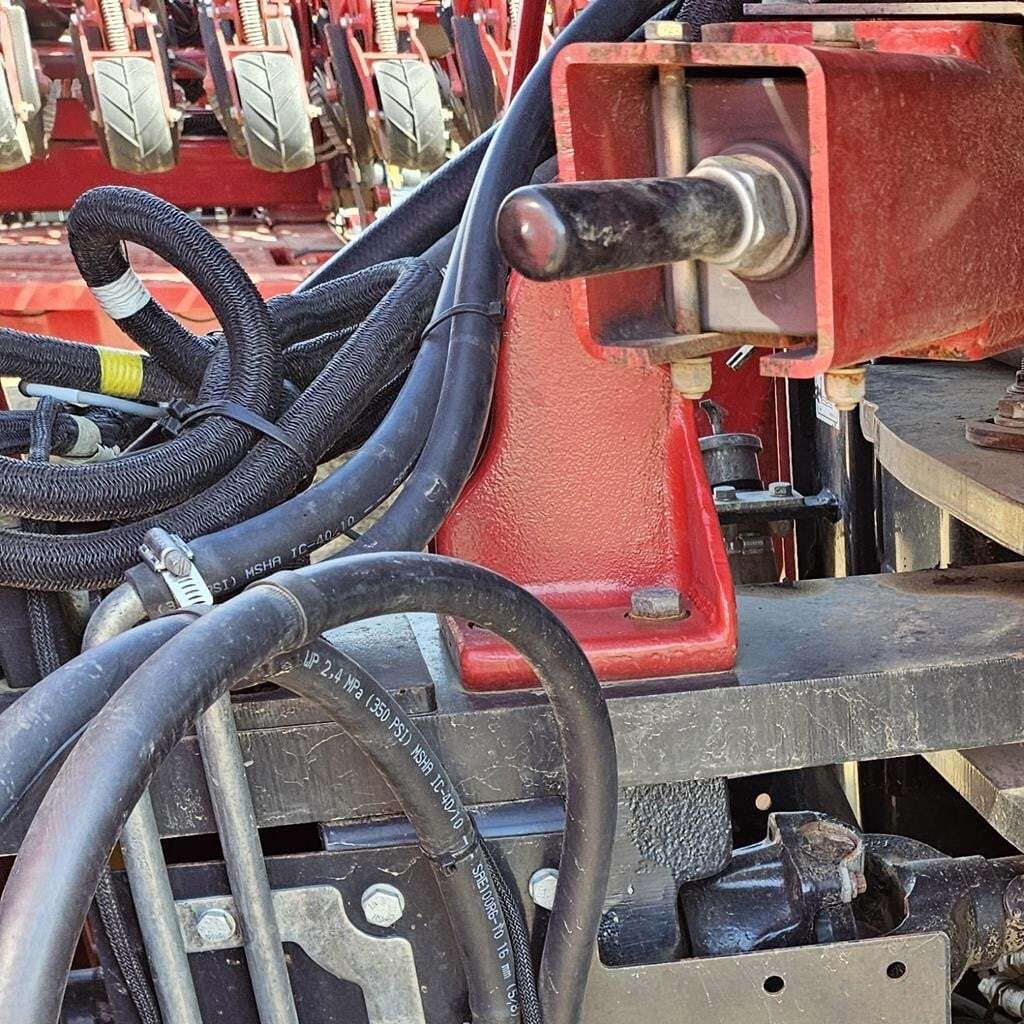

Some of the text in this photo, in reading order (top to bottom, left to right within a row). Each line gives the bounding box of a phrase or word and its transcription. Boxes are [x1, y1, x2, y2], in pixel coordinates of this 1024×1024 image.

[245, 555, 282, 579] MSHA
[303, 649, 464, 829] WP 2,4 MPa (350 PSI) MSHA IC-40/10
[472, 863, 505, 940] SAE100R6-10
[497, 942, 509, 959] 16
[501, 963, 512, 980] mm
